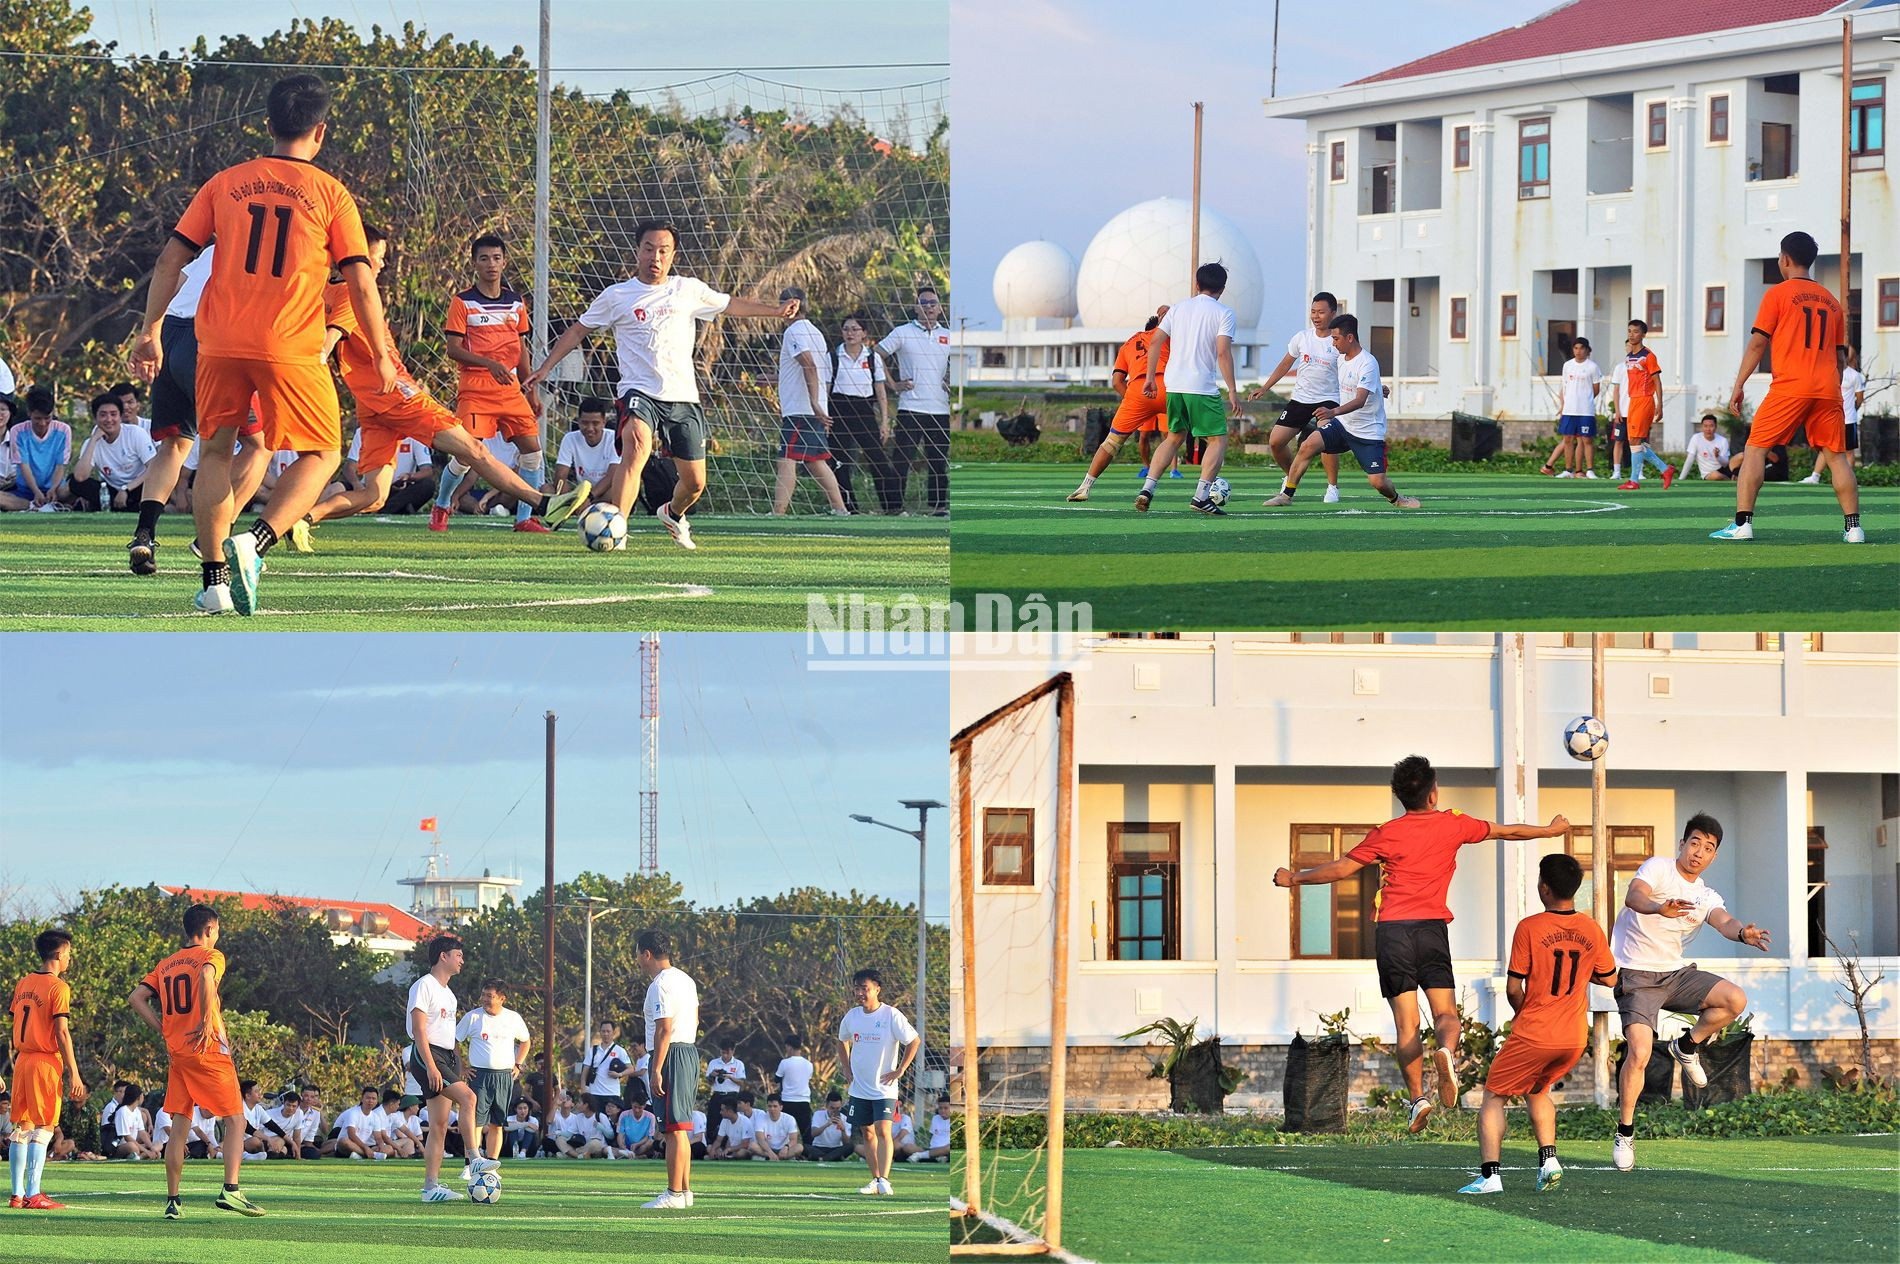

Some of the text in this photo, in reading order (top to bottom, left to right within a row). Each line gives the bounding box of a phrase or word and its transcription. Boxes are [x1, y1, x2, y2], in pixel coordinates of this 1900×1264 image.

[245, 202, 294, 277] 11
[1803, 306, 1828, 350] 11
[629, 396, 640, 408] 6
[1280, 410, 1288, 420] 8
[1551, 948, 1581, 997] 11
[164, 974, 193, 1016] 10
[21, 1004, 31, 1043] 1
[849, 1105, 855, 1116] 6
